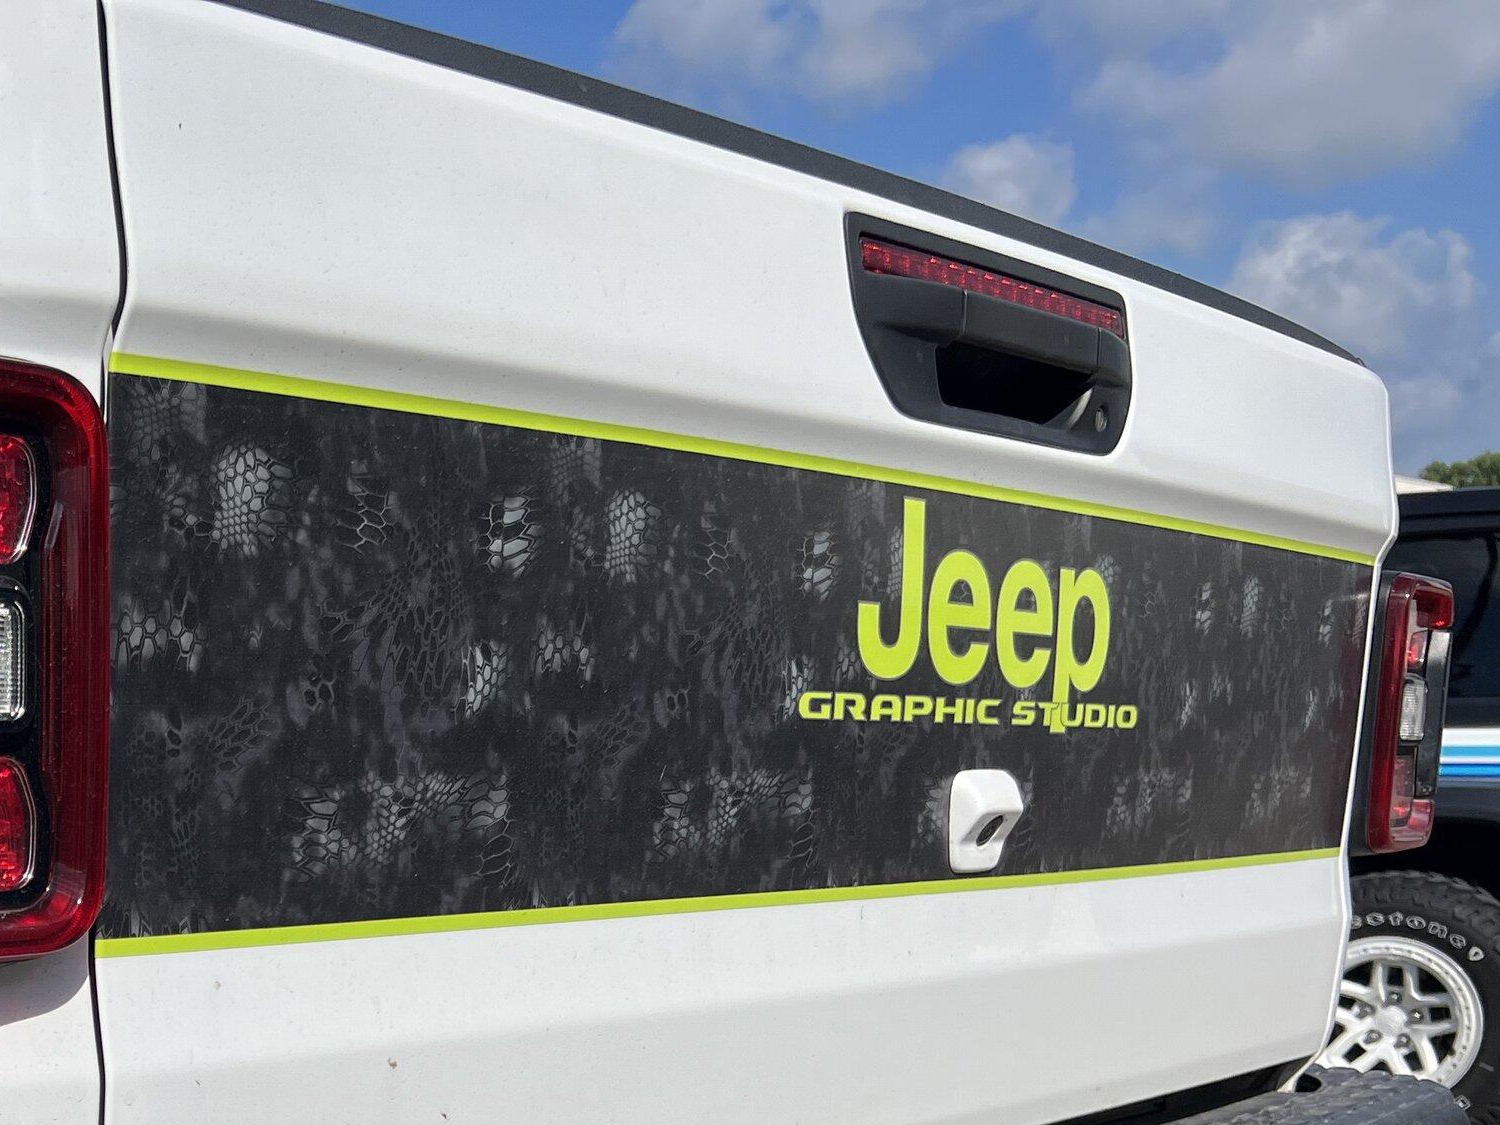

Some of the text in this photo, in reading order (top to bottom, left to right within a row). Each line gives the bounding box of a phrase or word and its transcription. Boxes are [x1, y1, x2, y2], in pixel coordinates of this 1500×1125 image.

[857, 497, 1111, 733] Jeep
[798, 690, 1138, 731] GRAPHIC STUDIO
